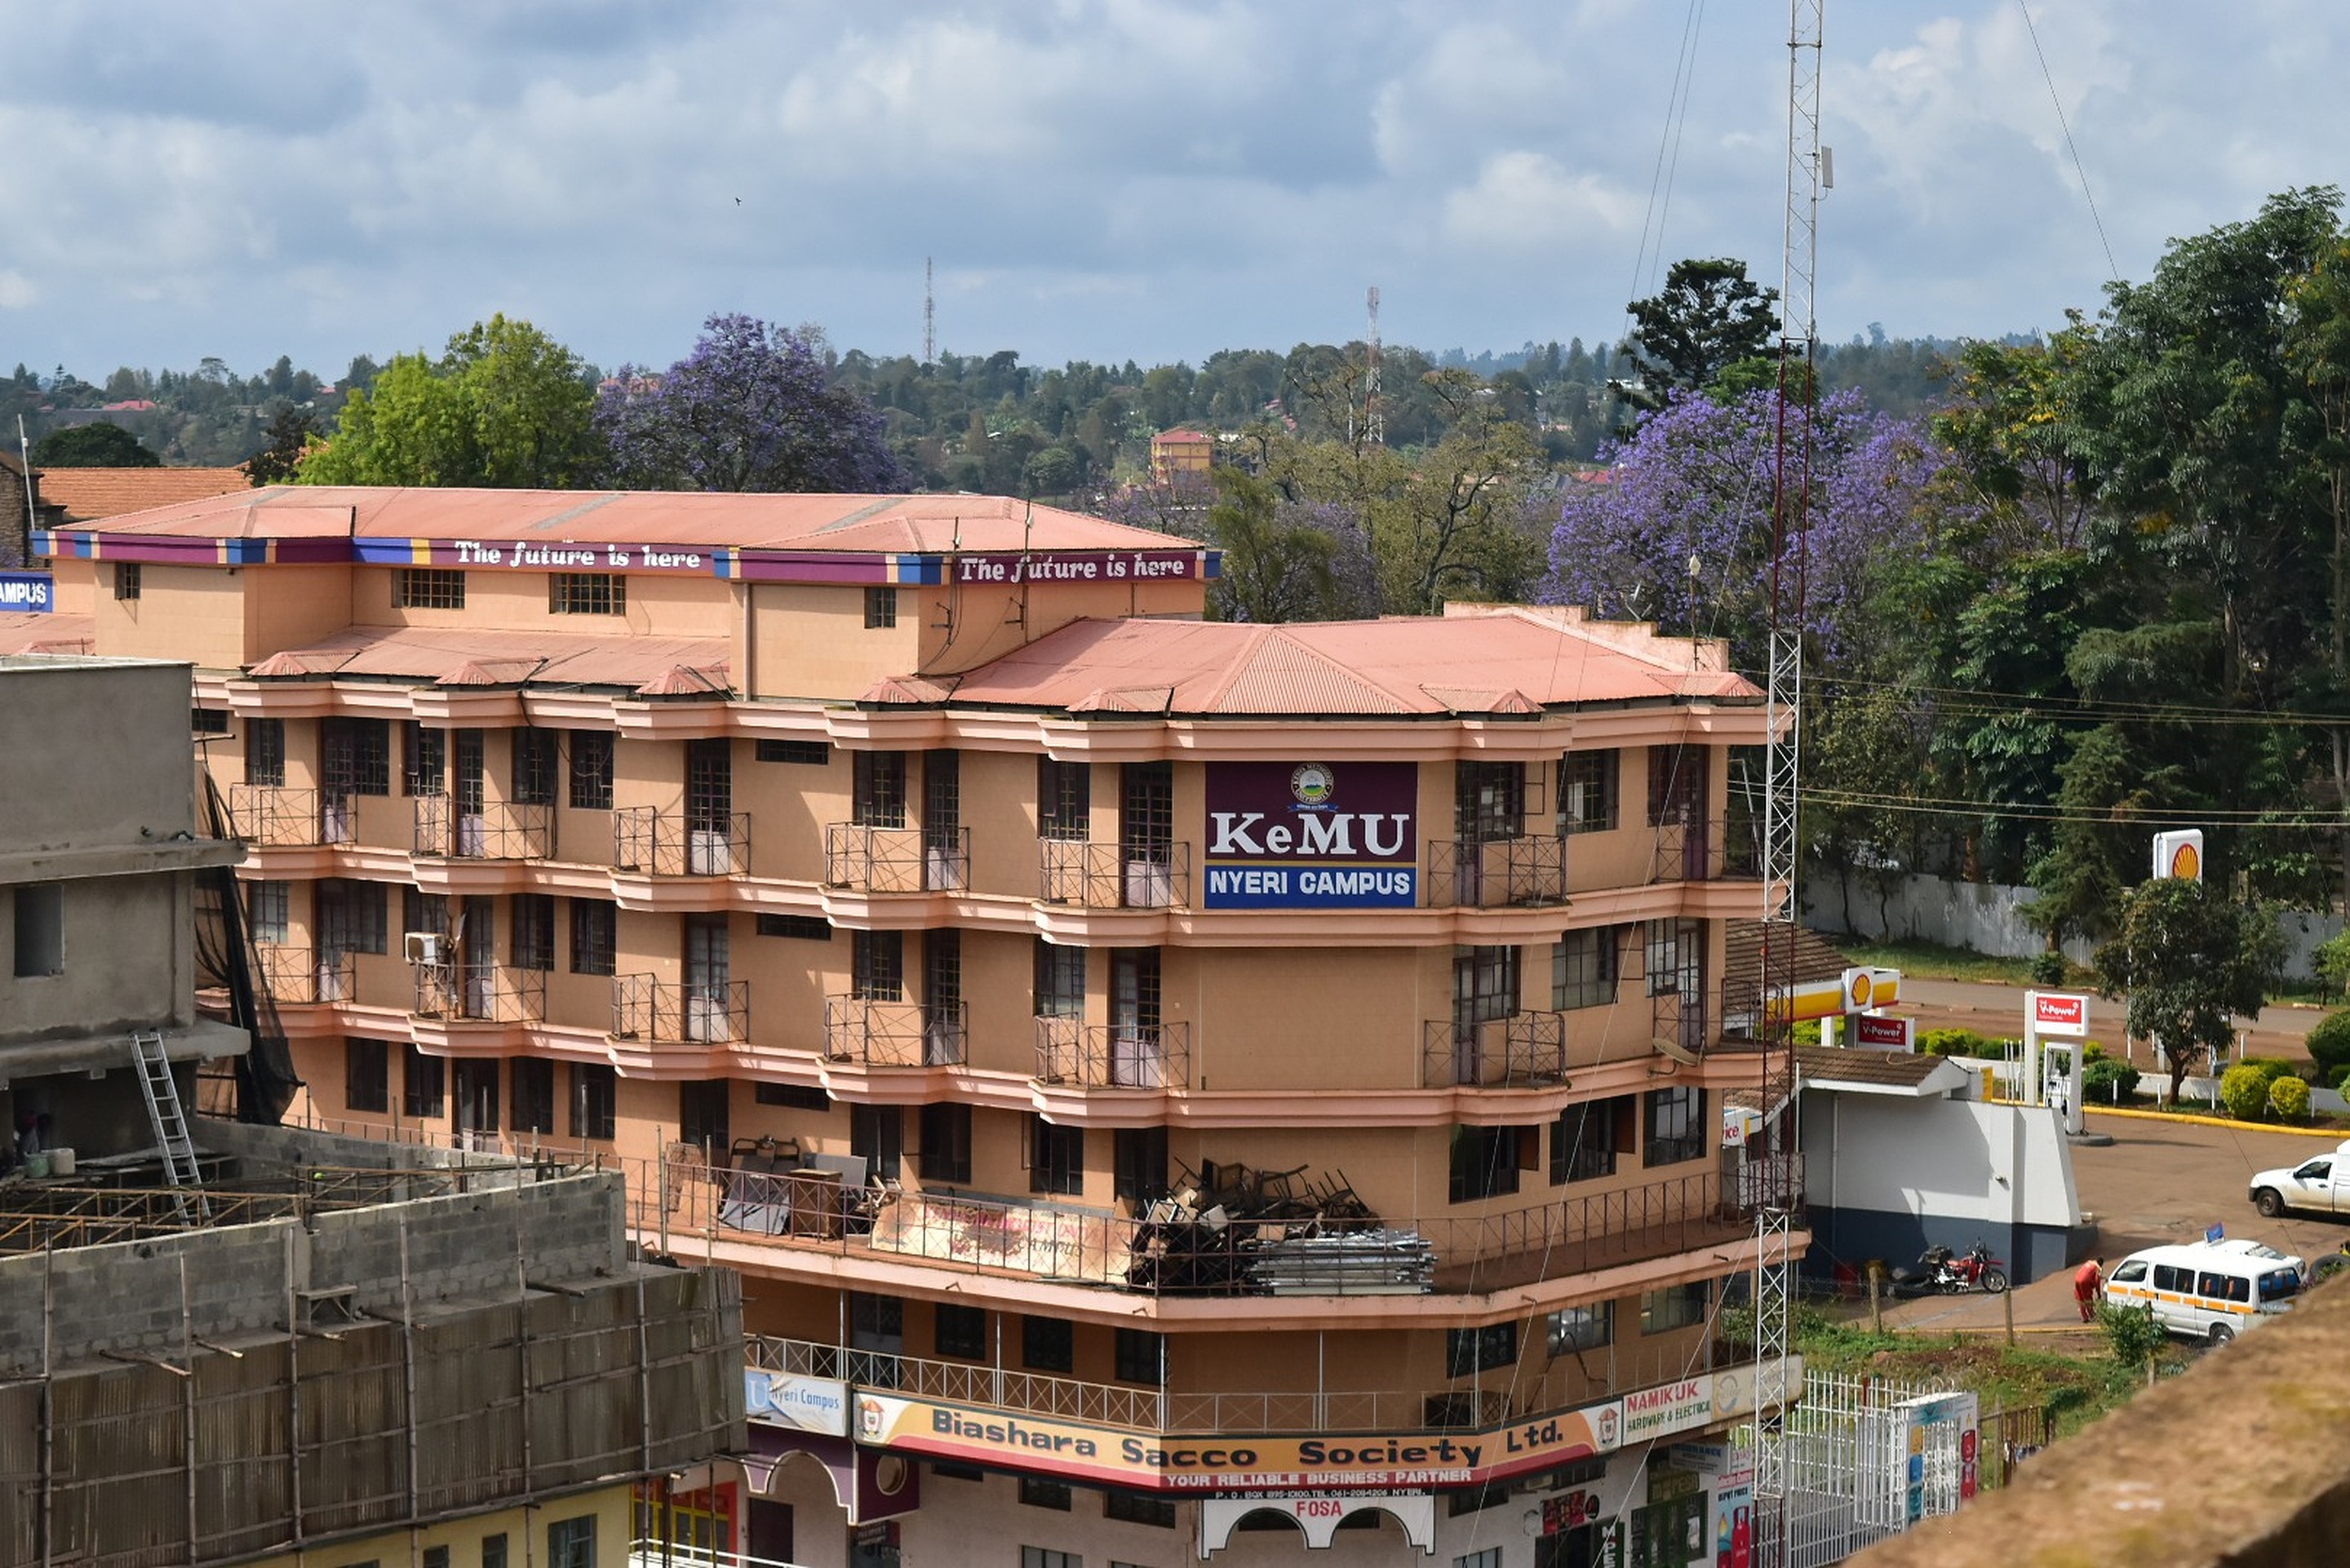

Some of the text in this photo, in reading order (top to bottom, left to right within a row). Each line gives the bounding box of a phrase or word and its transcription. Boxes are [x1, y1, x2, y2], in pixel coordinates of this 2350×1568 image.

[454, 541, 700, 568] The future is here
[960, 553, 1184, 583] The future is here
[1210, 813, 1409, 856] KeMU
[1210, 870, 1410, 895] NYERI CAMPUS
[800, 1389, 840, 1410] Campus
[932, 1409, 1563, 1468] Biashara Sacco Society Ltd.
[1167, 1470, 1471, 1487] YOUR RELIABLE BUSINESS PARTNER
[1296, 1500, 1342, 1517] FOSA
